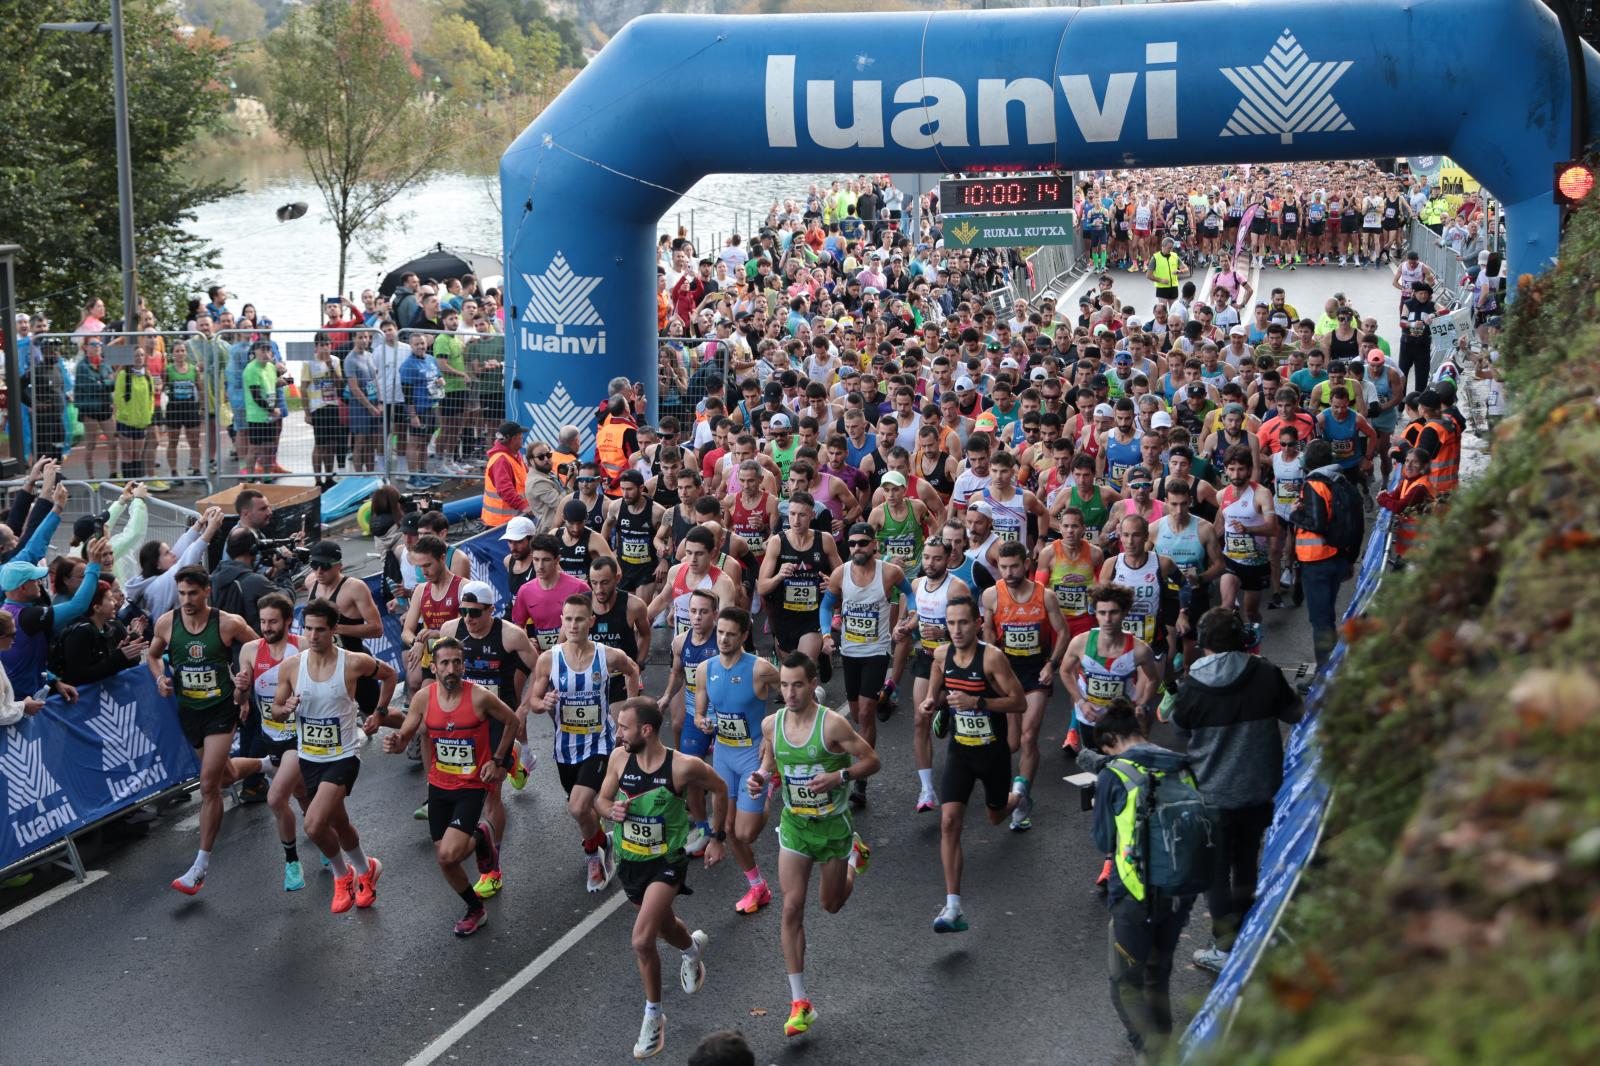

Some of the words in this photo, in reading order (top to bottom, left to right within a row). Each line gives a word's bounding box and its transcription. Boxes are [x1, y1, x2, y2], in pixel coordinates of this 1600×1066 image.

[765, 41, 1178, 150] luanvi
[983, 227, 1021, 238] RURAL
[1024, 225, 1066, 237] KUTXA
[521, 327, 606, 354] luanvi
[625, 544, 645, 552] 372
[1233, 539, 1246, 547] 64
[890, 547, 911, 555] 169
[794, 588, 809, 597] 29
[1059, 592, 1082, 602] 332
[850, 618, 873, 629] 359
[1009, 633, 1035, 642] 305
[185, 673, 212, 684] 115
[1092, 681, 1119, 692] 317
[576, 708, 585, 718] 6
[305, 717, 325, 725] luanvi
[959, 718, 985, 728] 186
[307, 726, 333, 738] 273
[440, 746, 468, 758] 375
[106, 755, 168, 802] luanvi
[798, 787, 817, 798] 66
[11, 795, 78, 848] luanvi
[632, 823, 651, 837] 98
